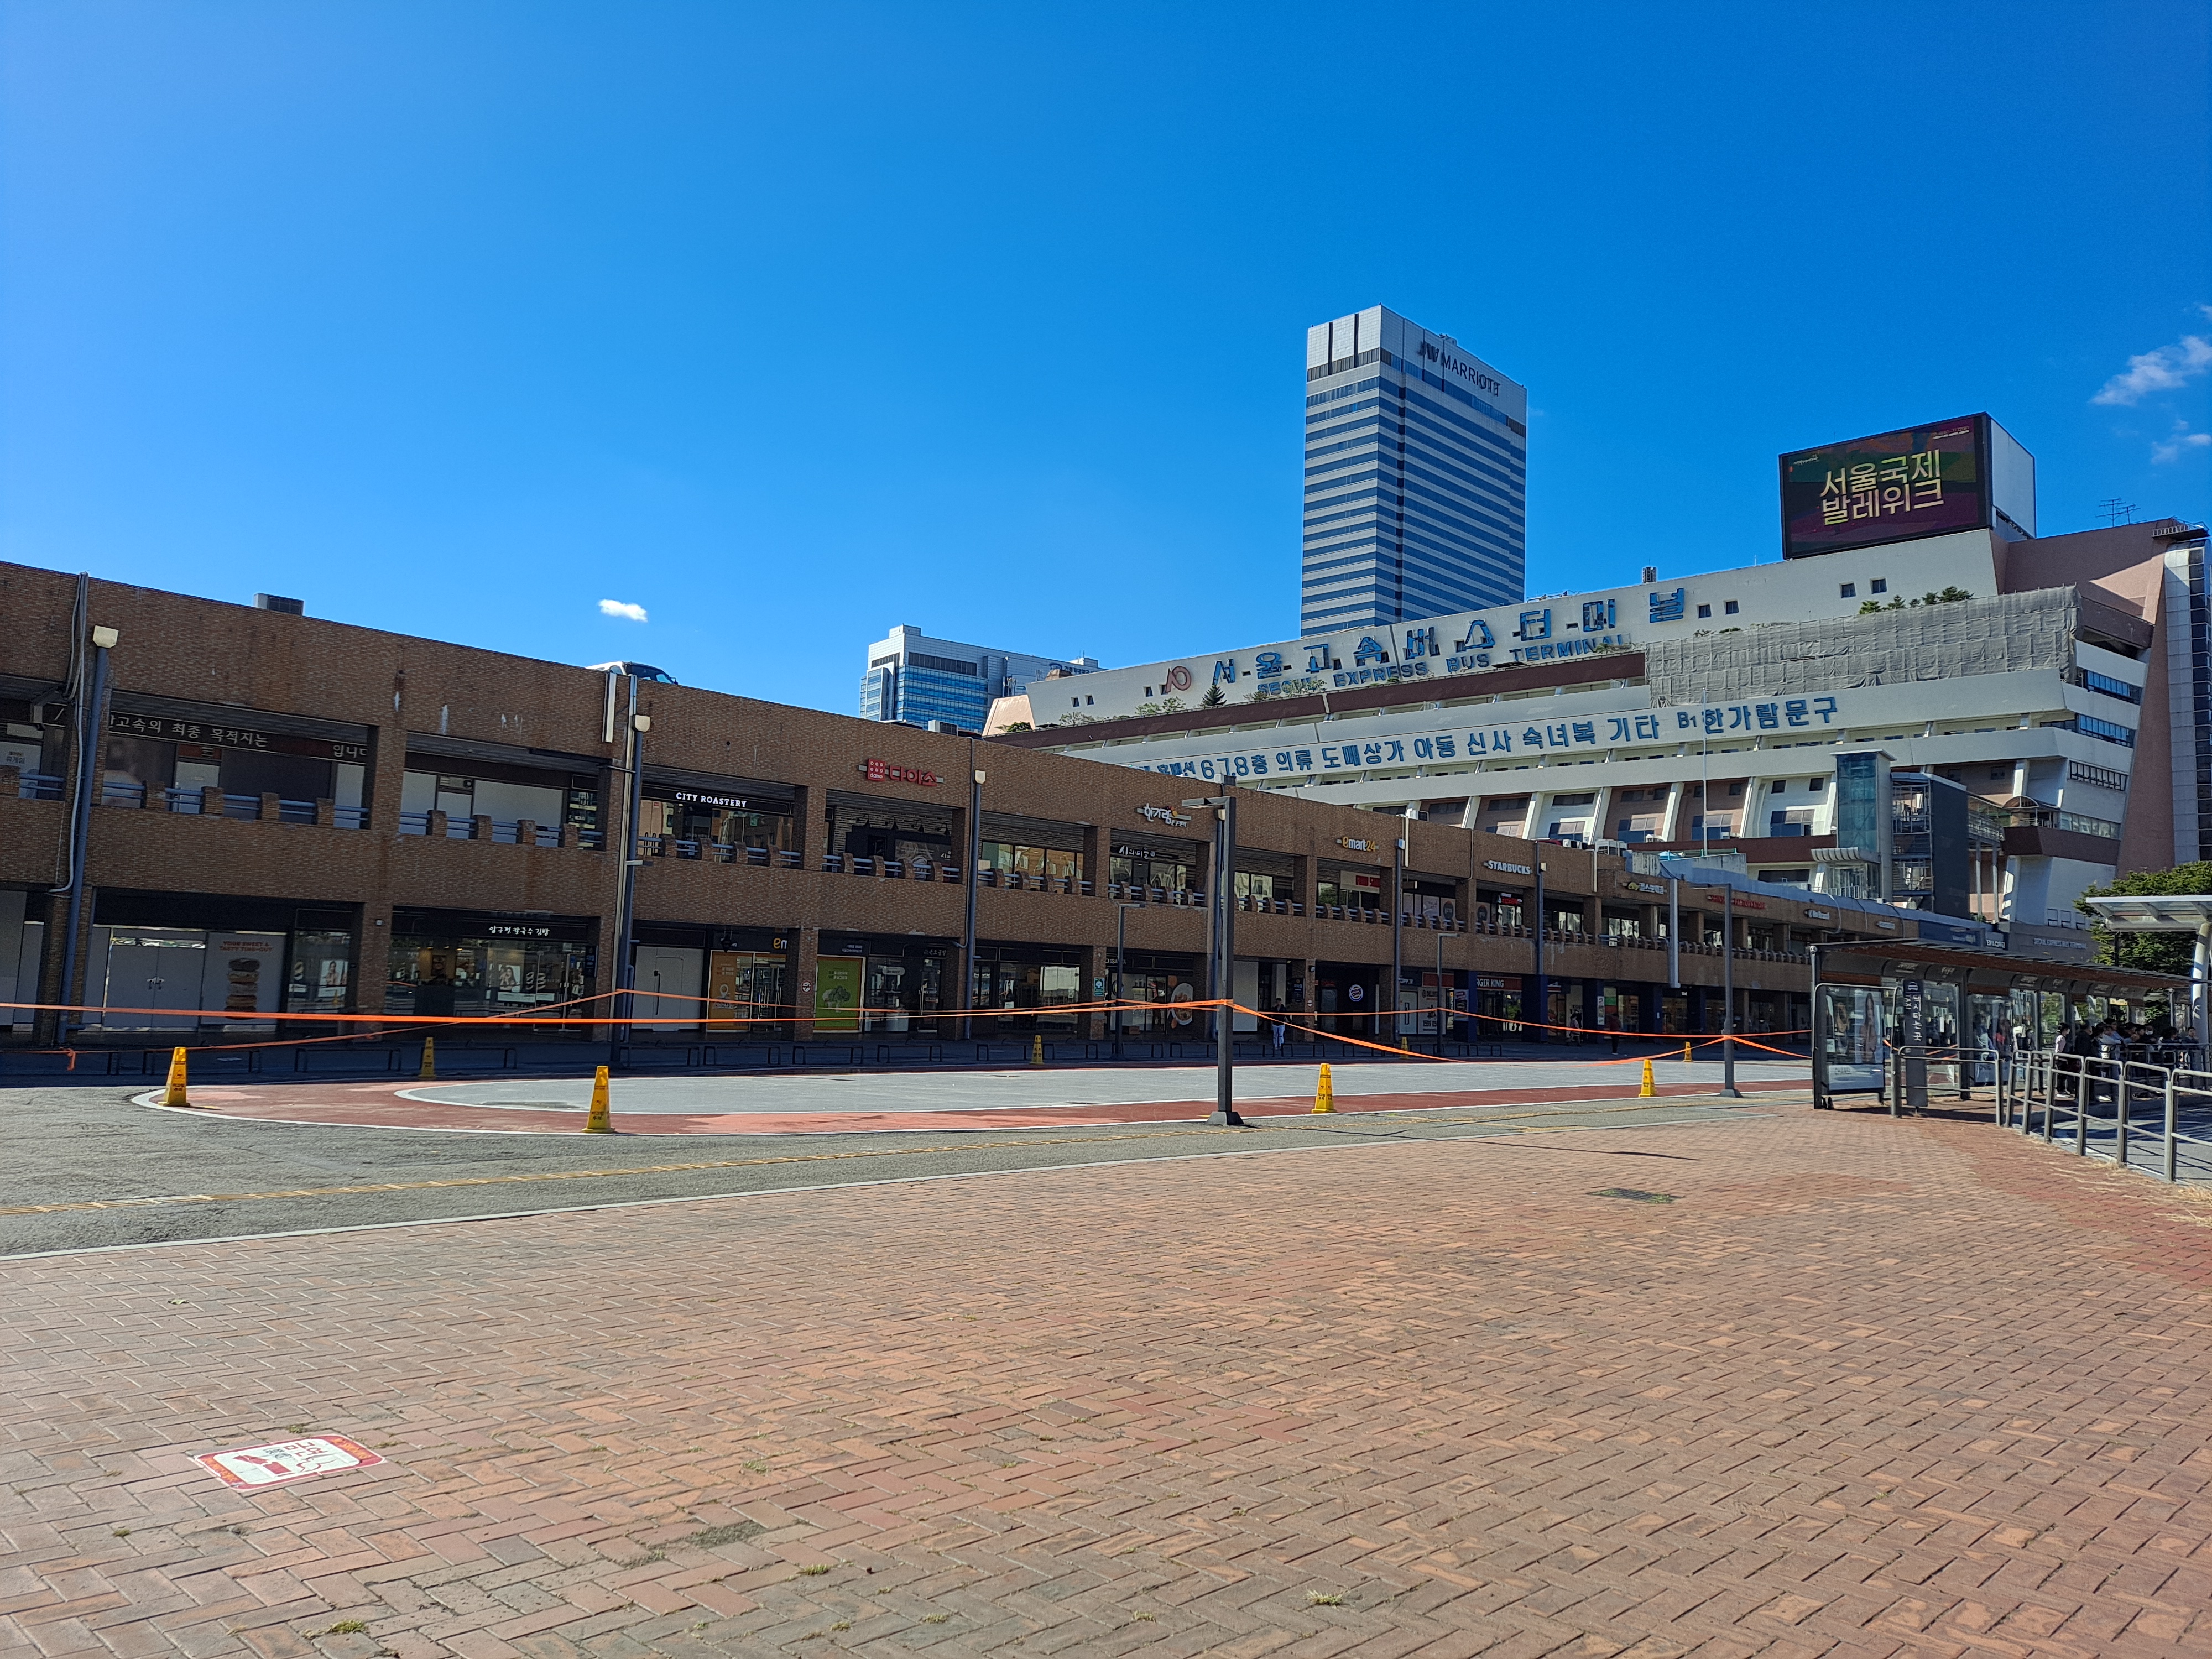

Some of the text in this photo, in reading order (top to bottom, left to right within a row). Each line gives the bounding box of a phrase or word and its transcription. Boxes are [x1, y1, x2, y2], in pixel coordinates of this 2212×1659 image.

[1418, 341, 1501, 397] JW MARRIOTT
[1820, 448, 1941, 497] 서울국제
[1822, 478, 1945, 525] 발레위크
[1333, 661, 1427, 687] EXPRESS
[1446, 653, 1490, 672] BUS
[171, 723, 201, 739] 최종
[210, 728, 269, 748] 목적지는
[1276, 748, 1313, 772] 의류
[1321, 740, 1404, 769] 도매상가
[1413, 735, 1456, 760] 아동
[1467, 730, 1511, 755] 신사
[1522, 721, 1596, 749] 숙녀복
[1607, 714, 1660, 742] 기타
[888, 765, 938, 787] 다이소
[676, 792, 747, 808] CITY ROASTERY
[1342, 836, 1376, 852] emart24
[1488, 860, 1530, 875] STARBUCKS
[1490, 978, 1505, 988] KING
